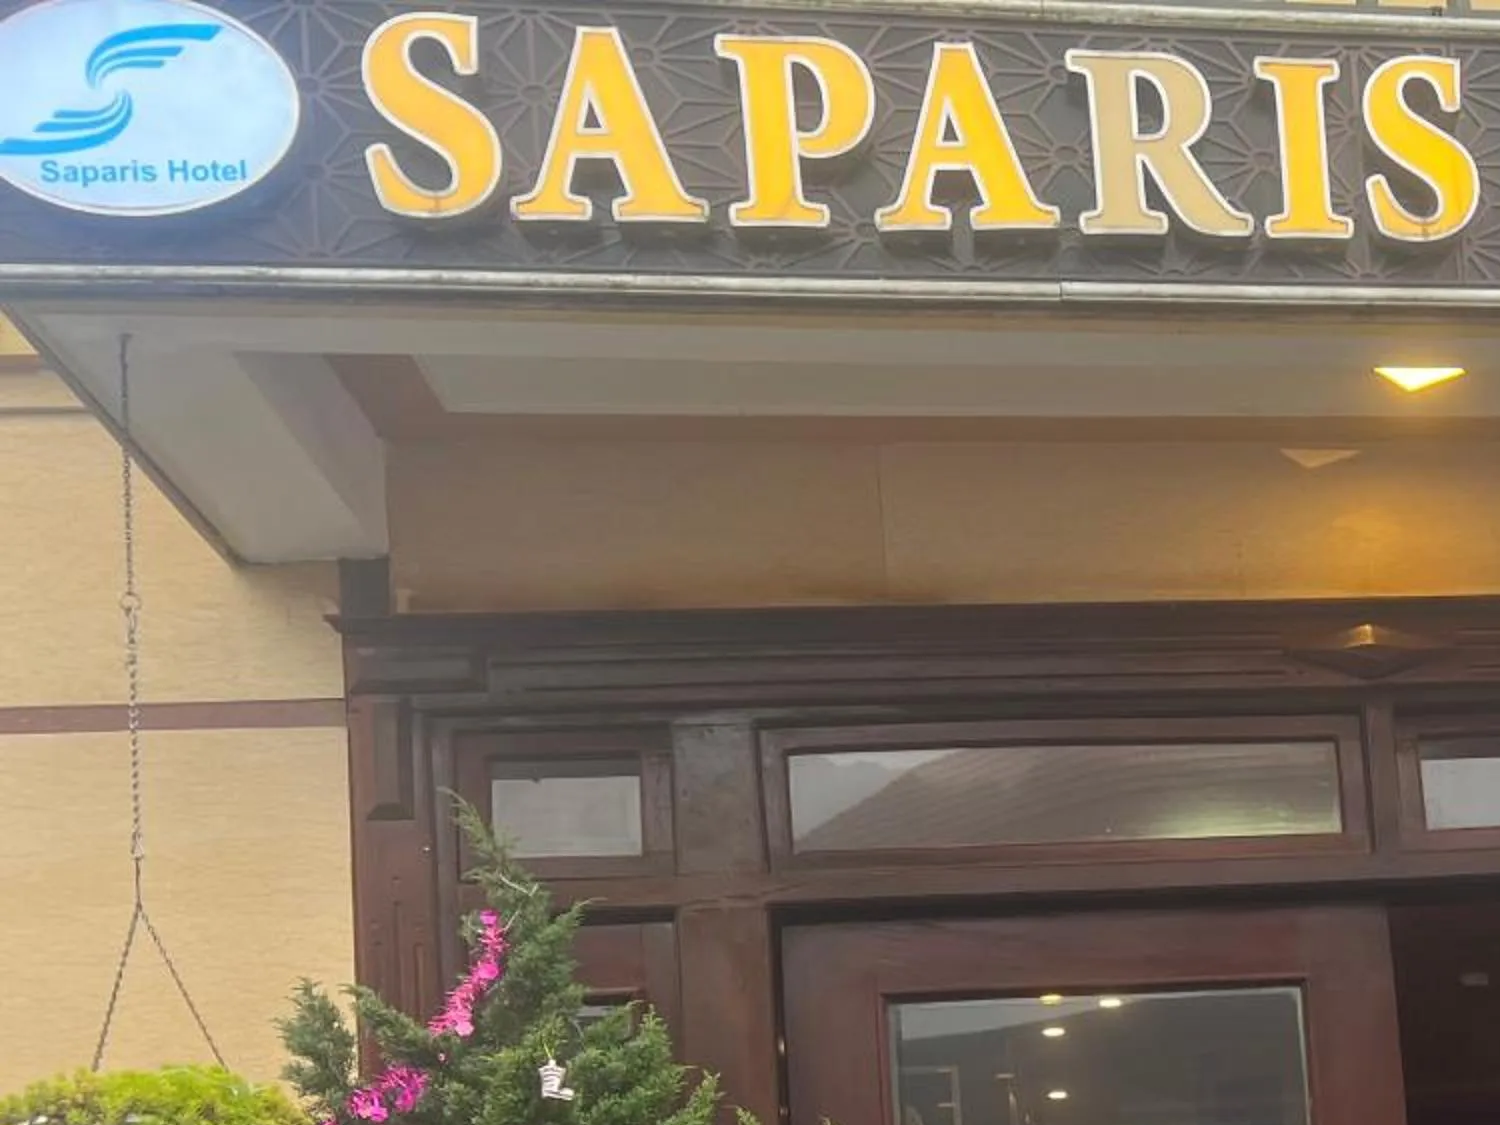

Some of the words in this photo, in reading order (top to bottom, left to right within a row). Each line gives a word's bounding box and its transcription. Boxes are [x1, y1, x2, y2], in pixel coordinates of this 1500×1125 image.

[41, 159, 157, 187] Saparis
[168, 159, 247, 182] Hotel
[361, 13, 1481, 242] SAPARIS
